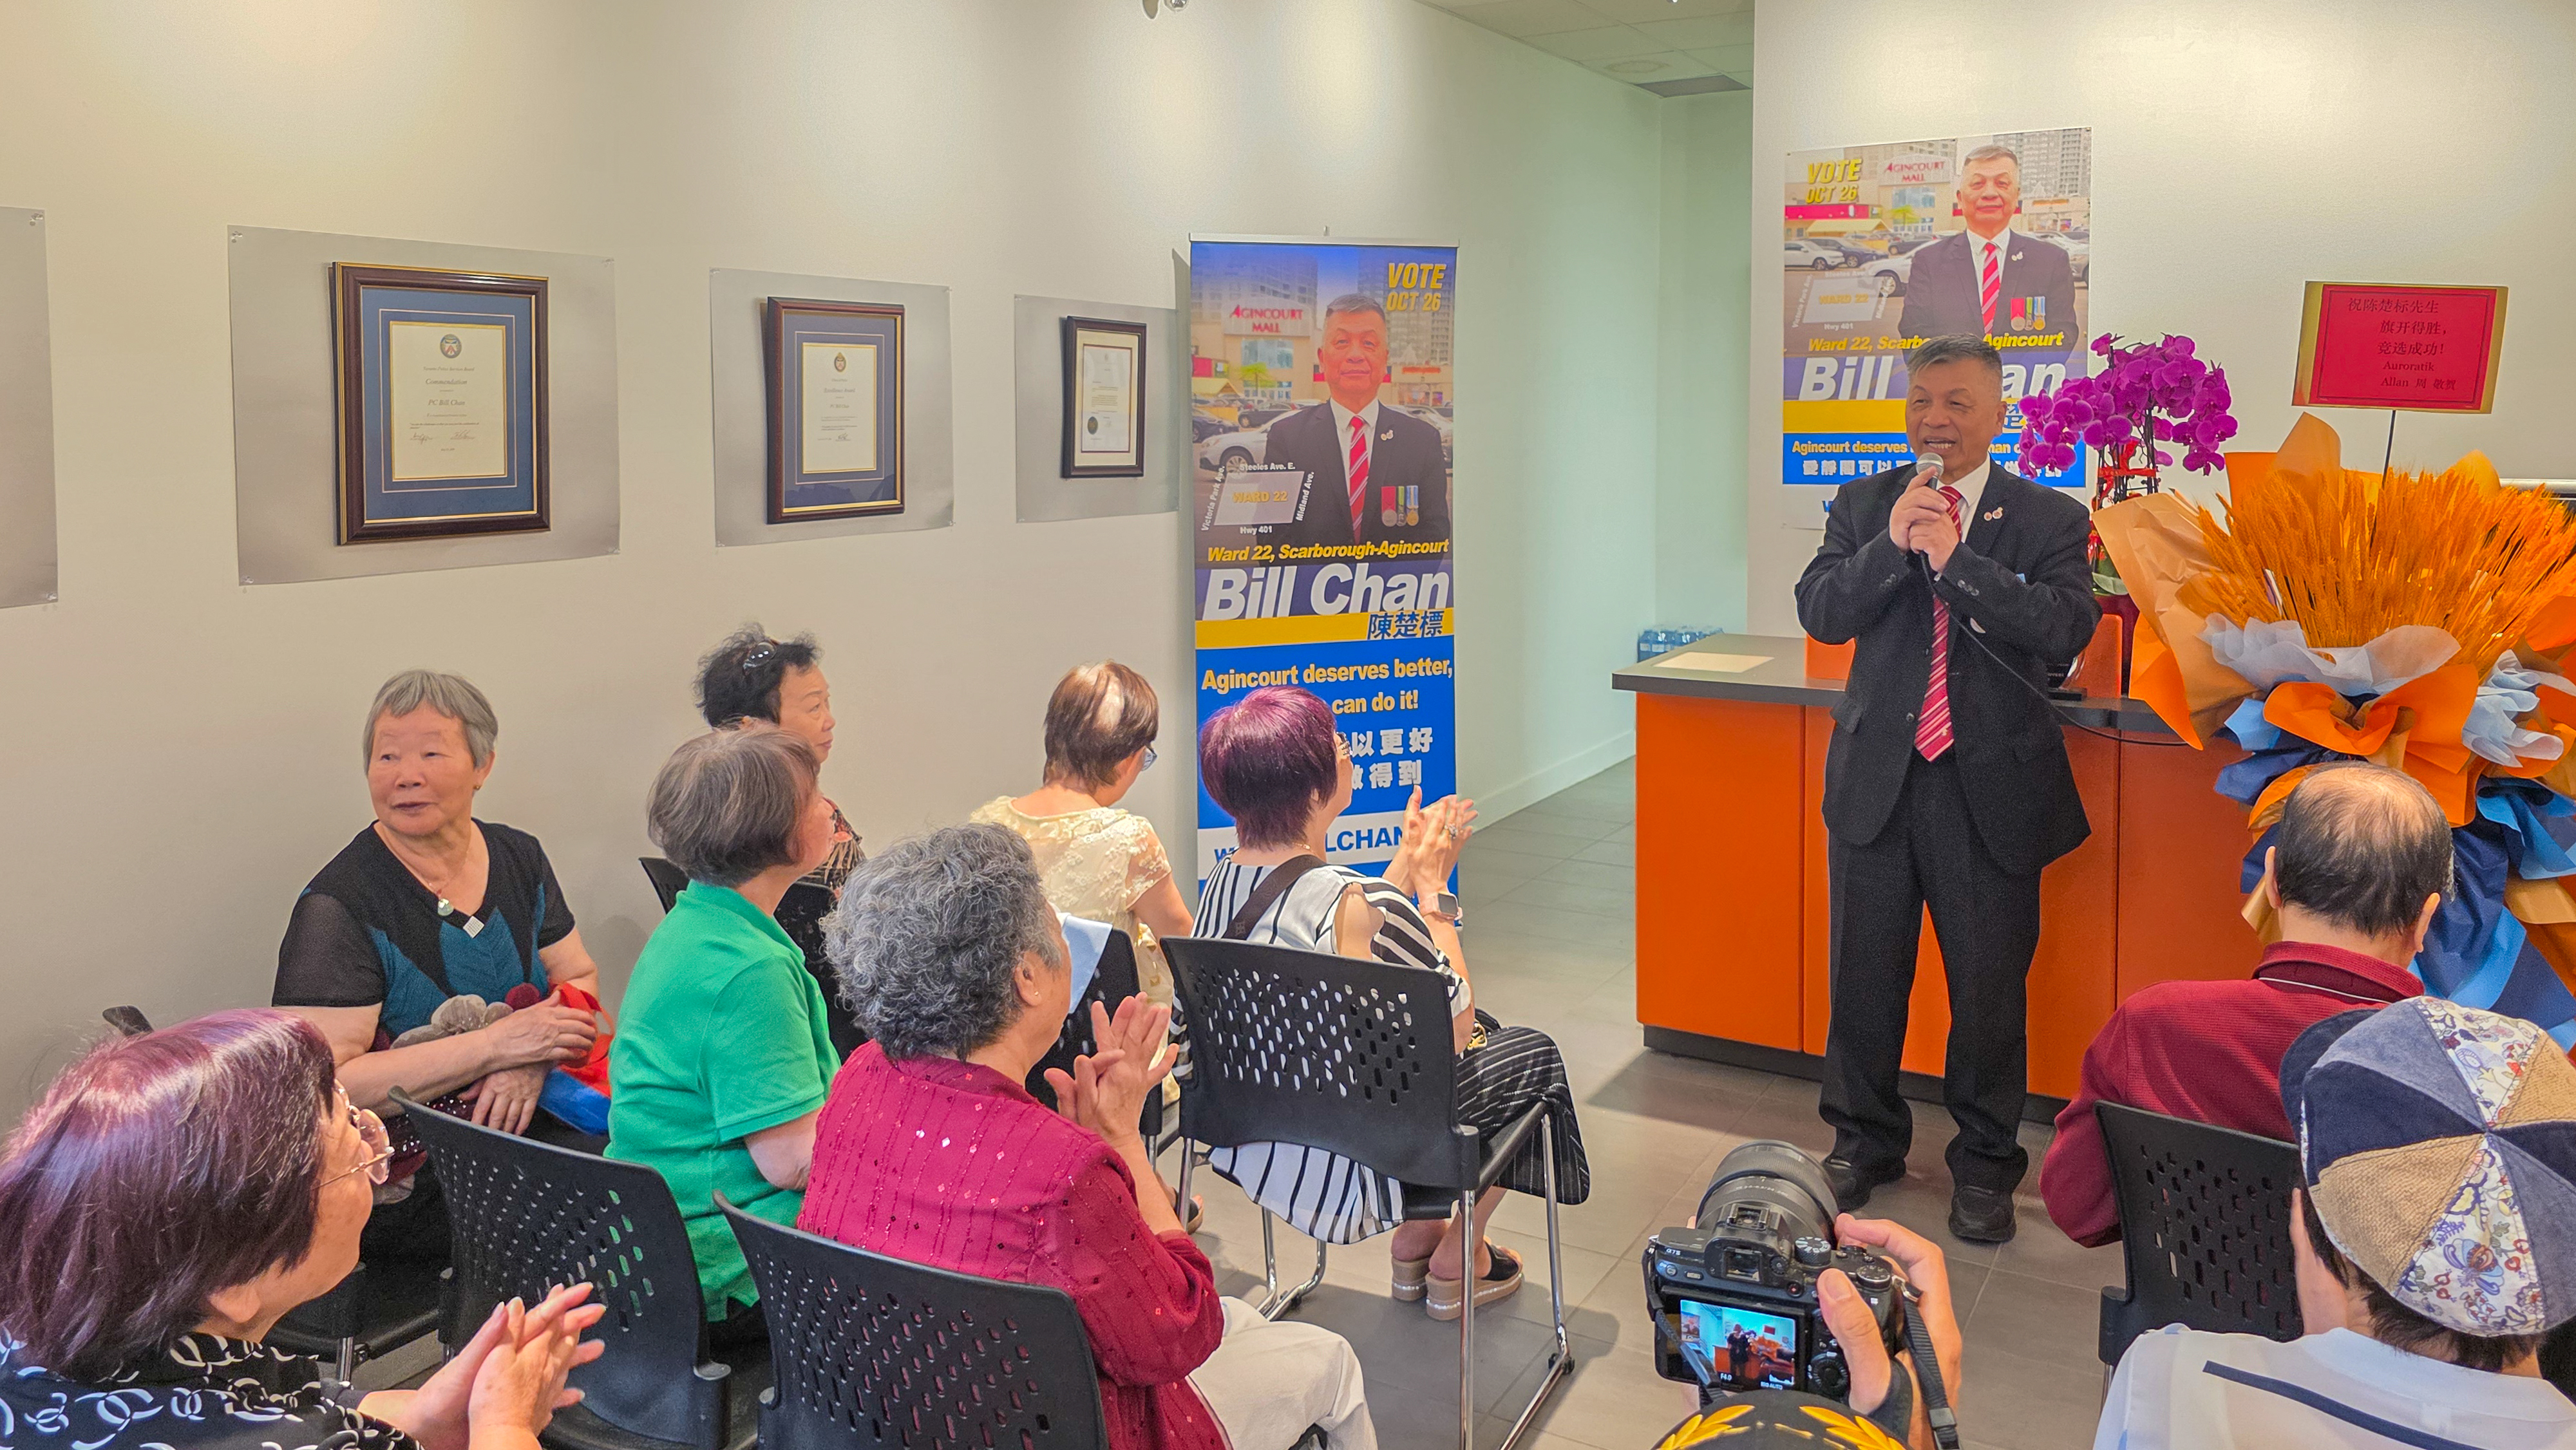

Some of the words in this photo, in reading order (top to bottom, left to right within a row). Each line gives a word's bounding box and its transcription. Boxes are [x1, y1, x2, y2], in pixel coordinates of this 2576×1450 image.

[1808, 158, 1862, 184] VOTE
[1884, 161, 1945, 173] AGINCOURT
[1902, 174, 1925, 182] MALL
[1806, 186, 1836, 203] OCT
[1839, 184, 1859, 202] 26
[1388, 263, 1447, 289] VOTE
[1386, 292, 1419, 312] OCT
[1422, 292, 1441, 311] 26
[2347, 297, 2439, 314] 祝陈楚标先生
[1229, 305, 1303, 321] AGINCOURT
[1252, 323, 1281, 333] MALL
[1808, 337, 1847, 352] Ward
[1850, 337, 1874, 353] 22,
[2383, 361, 2435, 372] Auroratik
[1799, 355, 1894, 401] Bill
[2001, 362, 2067, 400] an
[2381, 377, 2409, 388] Allan
[1792, 441, 1850, 455] Agincourt
[1852, 441, 1908, 453] deserves
[1270, 462, 1287, 471] Ave.
[1201, 502, 1216, 532] Victoria
[1209, 482, 1221, 501] Park
[1215, 466, 1226, 482] Ave.
[1233, 491, 1271, 504] WARD
[1273, 490, 1288, 502] 22
[1296, 489, 1311, 522] Midland
[1304, 471, 1315, 489] Ave.
[1240, 527, 1258, 536] Hwy
[1258, 525, 1273, 534] 401
[1208, 546, 1250, 562] Ward
[1251, 545, 1276, 563] 22,
[1278, 538, 1450, 561] Scarborough-Agincourt
[1202, 565, 1298, 622] Bill
[1310, 562, 1450, 616] Chan
[1367, 610, 1444, 641] 陳楚標
[1201, 665, 1298, 695] Agincourt
[1303, 661, 1390, 684] deserves
[1394, 657, 1454, 680] better,
[1331, 697, 1367, 715] can
[1371, 691, 1396, 712] do
[1399, 689, 1419, 710] it!
[1352, 727, 1434, 757] 以更好
